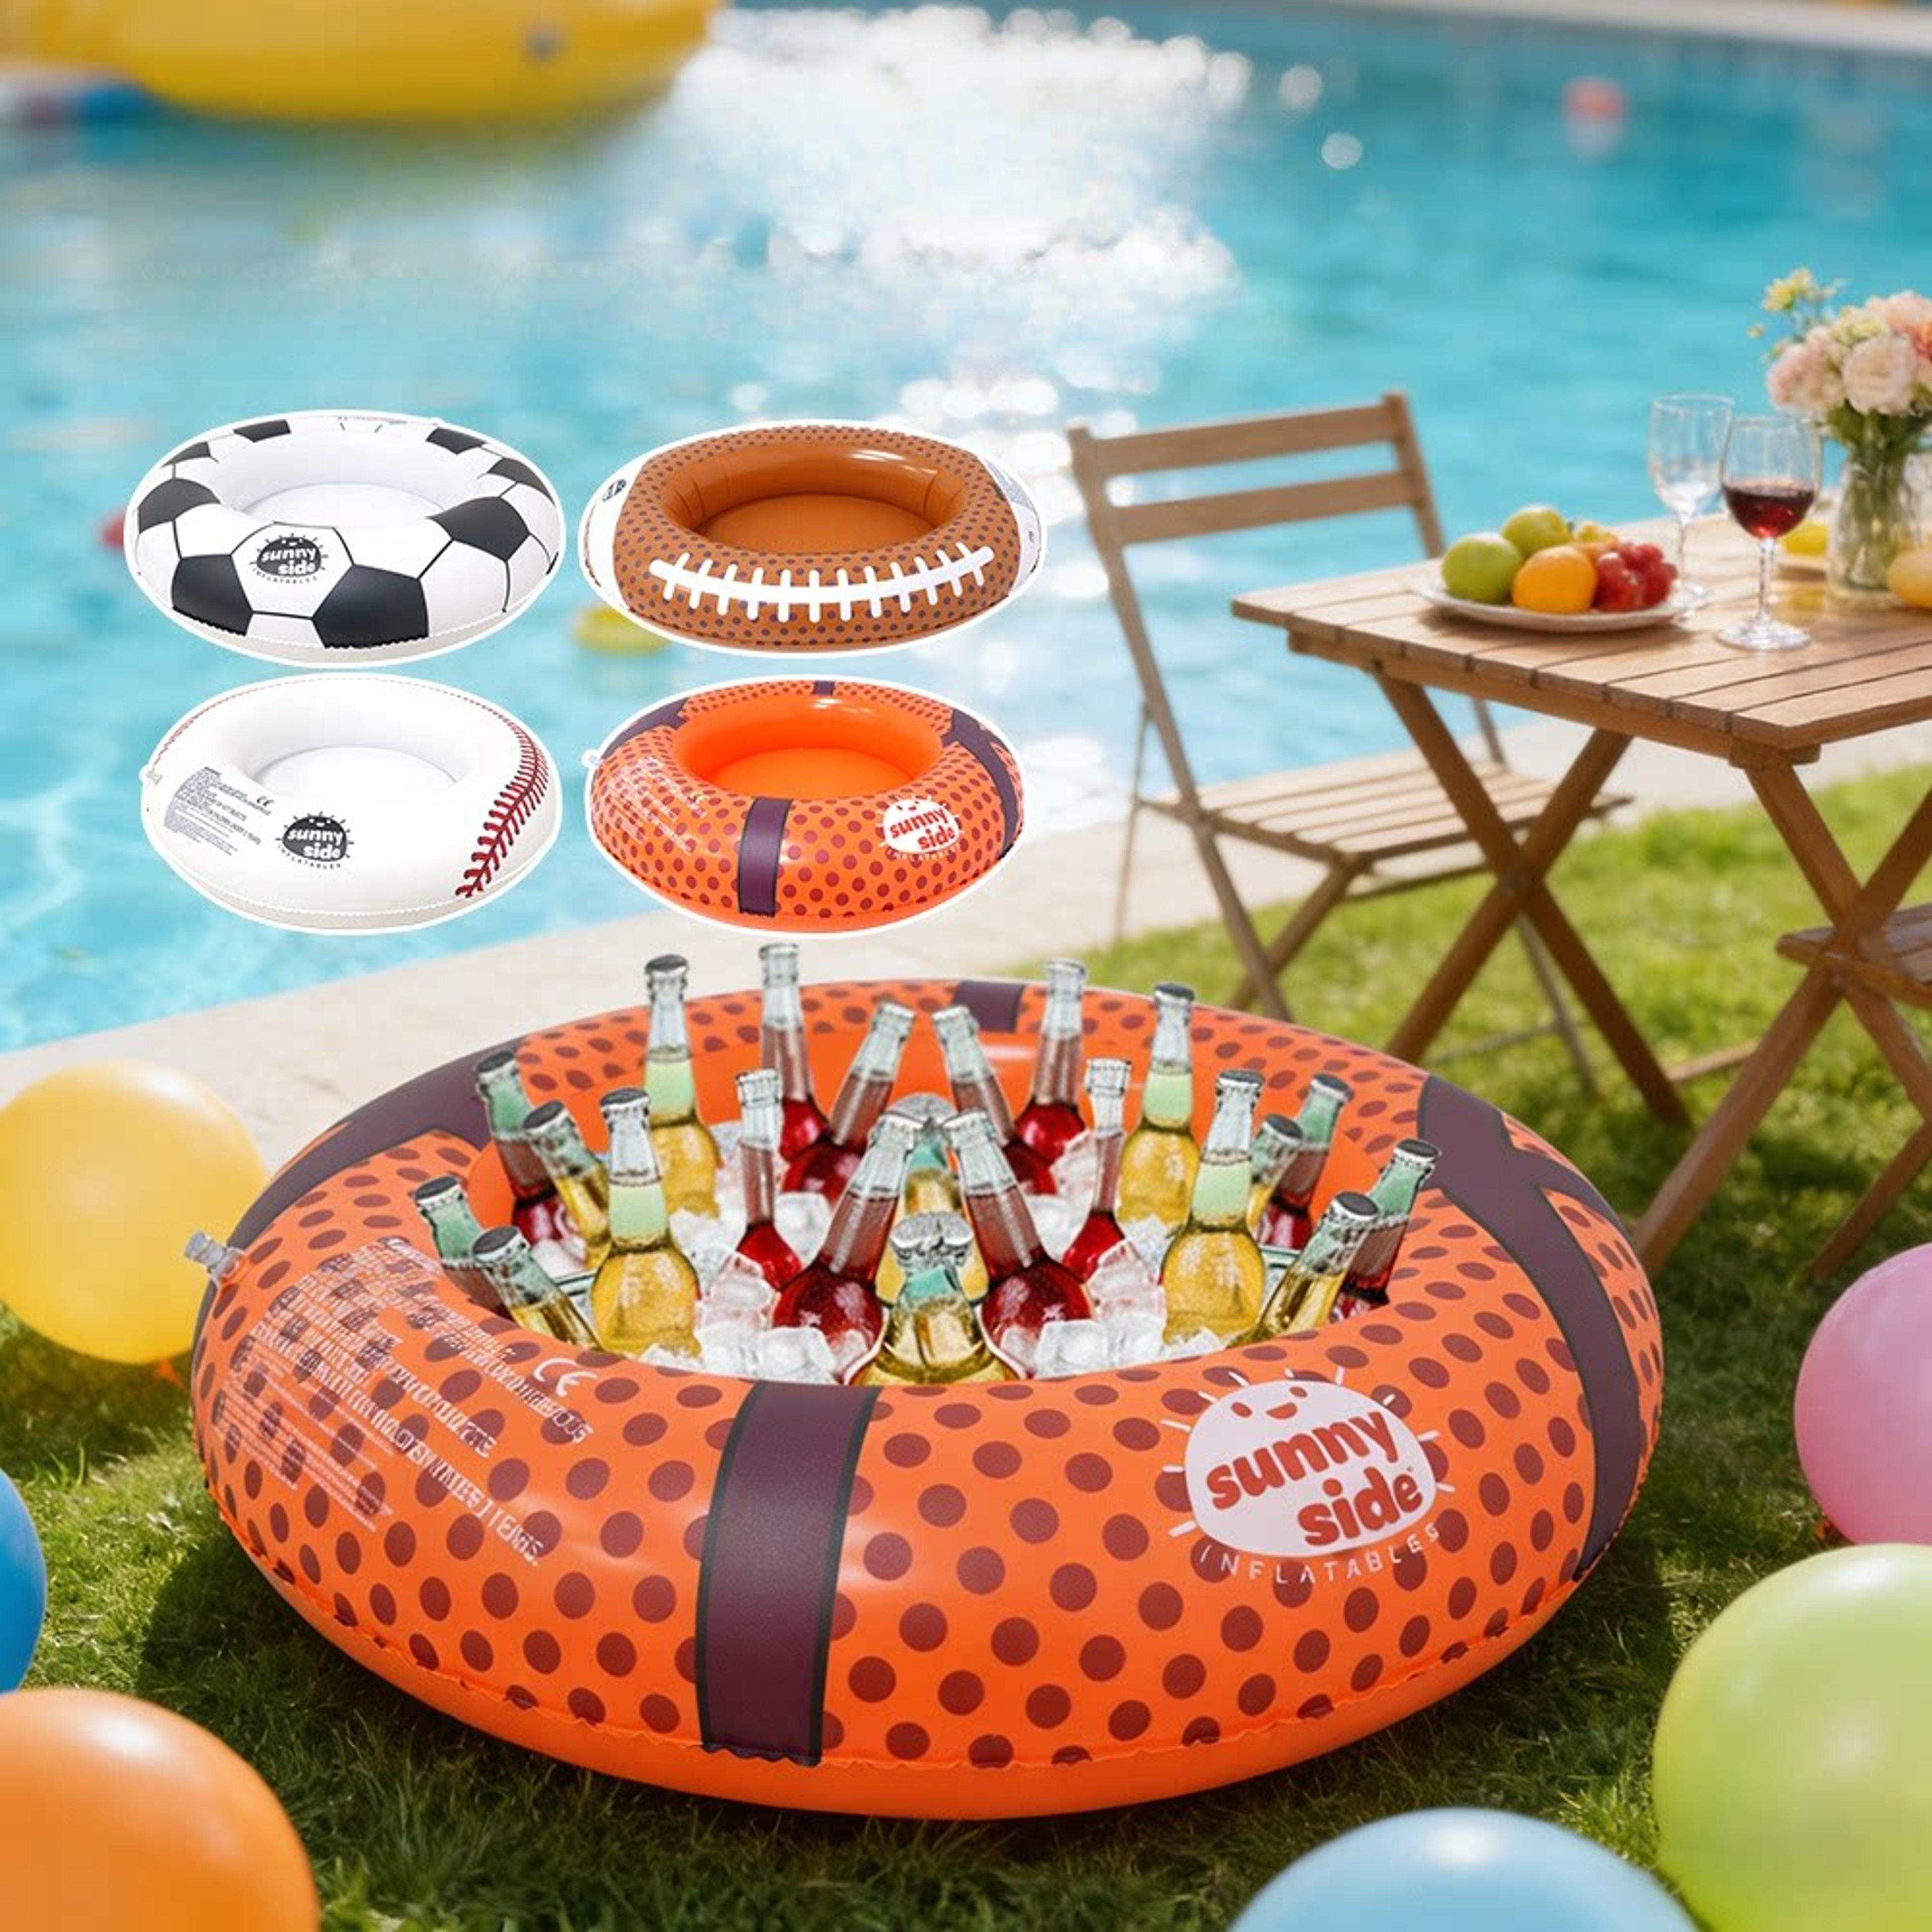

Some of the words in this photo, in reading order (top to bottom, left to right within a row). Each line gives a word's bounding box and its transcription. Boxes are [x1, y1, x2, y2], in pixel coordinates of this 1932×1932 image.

[261, 548, 316, 562] sunny
[278, 559, 315, 574] side
[890, 809, 948, 839] sunny
[287, 829, 343, 846] sunny
[918, 825, 955, 850] side
[303, 842, 341, 860] side
[1206, 1411, 1399, 1510] sunny
[1298, 1466, 1423, 1547] side
[1199, 1522, 1440, 1585] INFLATABLES
